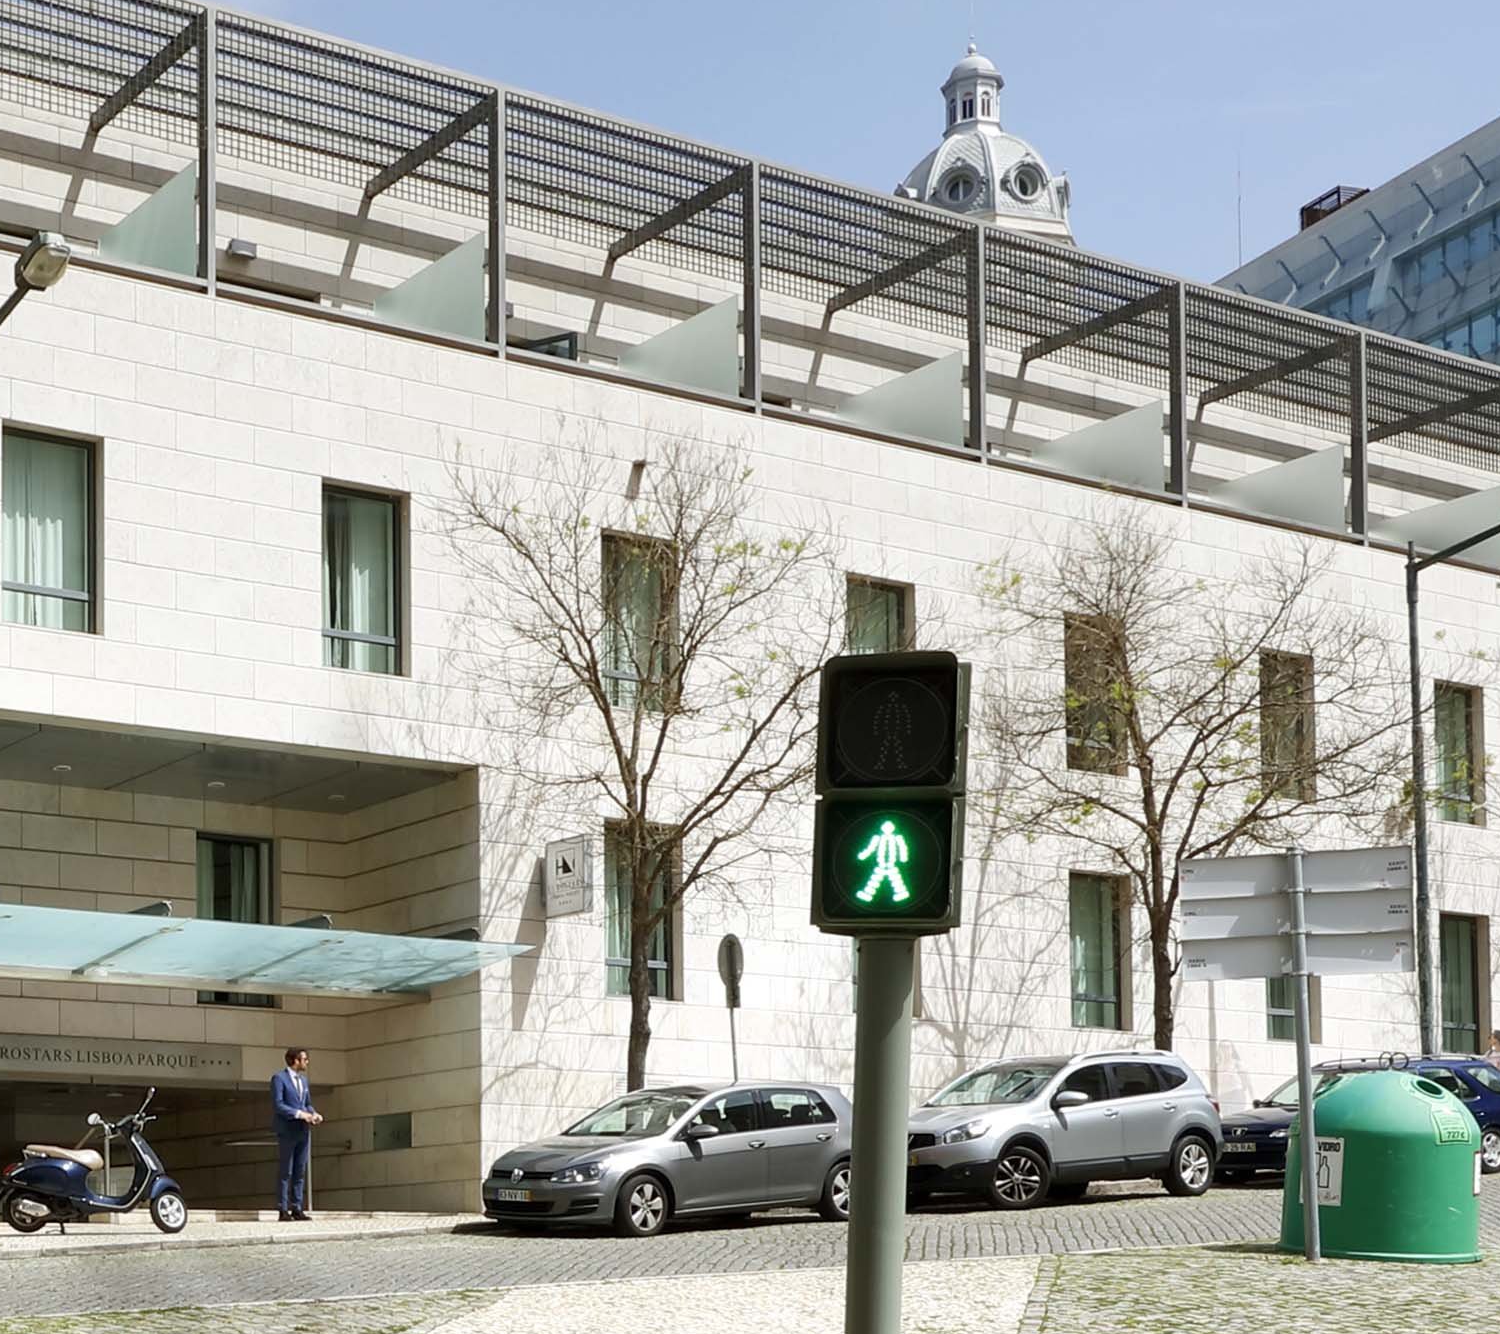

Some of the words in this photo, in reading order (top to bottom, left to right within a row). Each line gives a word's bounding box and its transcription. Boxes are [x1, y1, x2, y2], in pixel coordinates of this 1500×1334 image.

[76, 1048, 134, 1065] LISBOA
[138, 1052, 198, 1069] PARQUE
[1317, 1141, 1341, 1153] VIDRO
